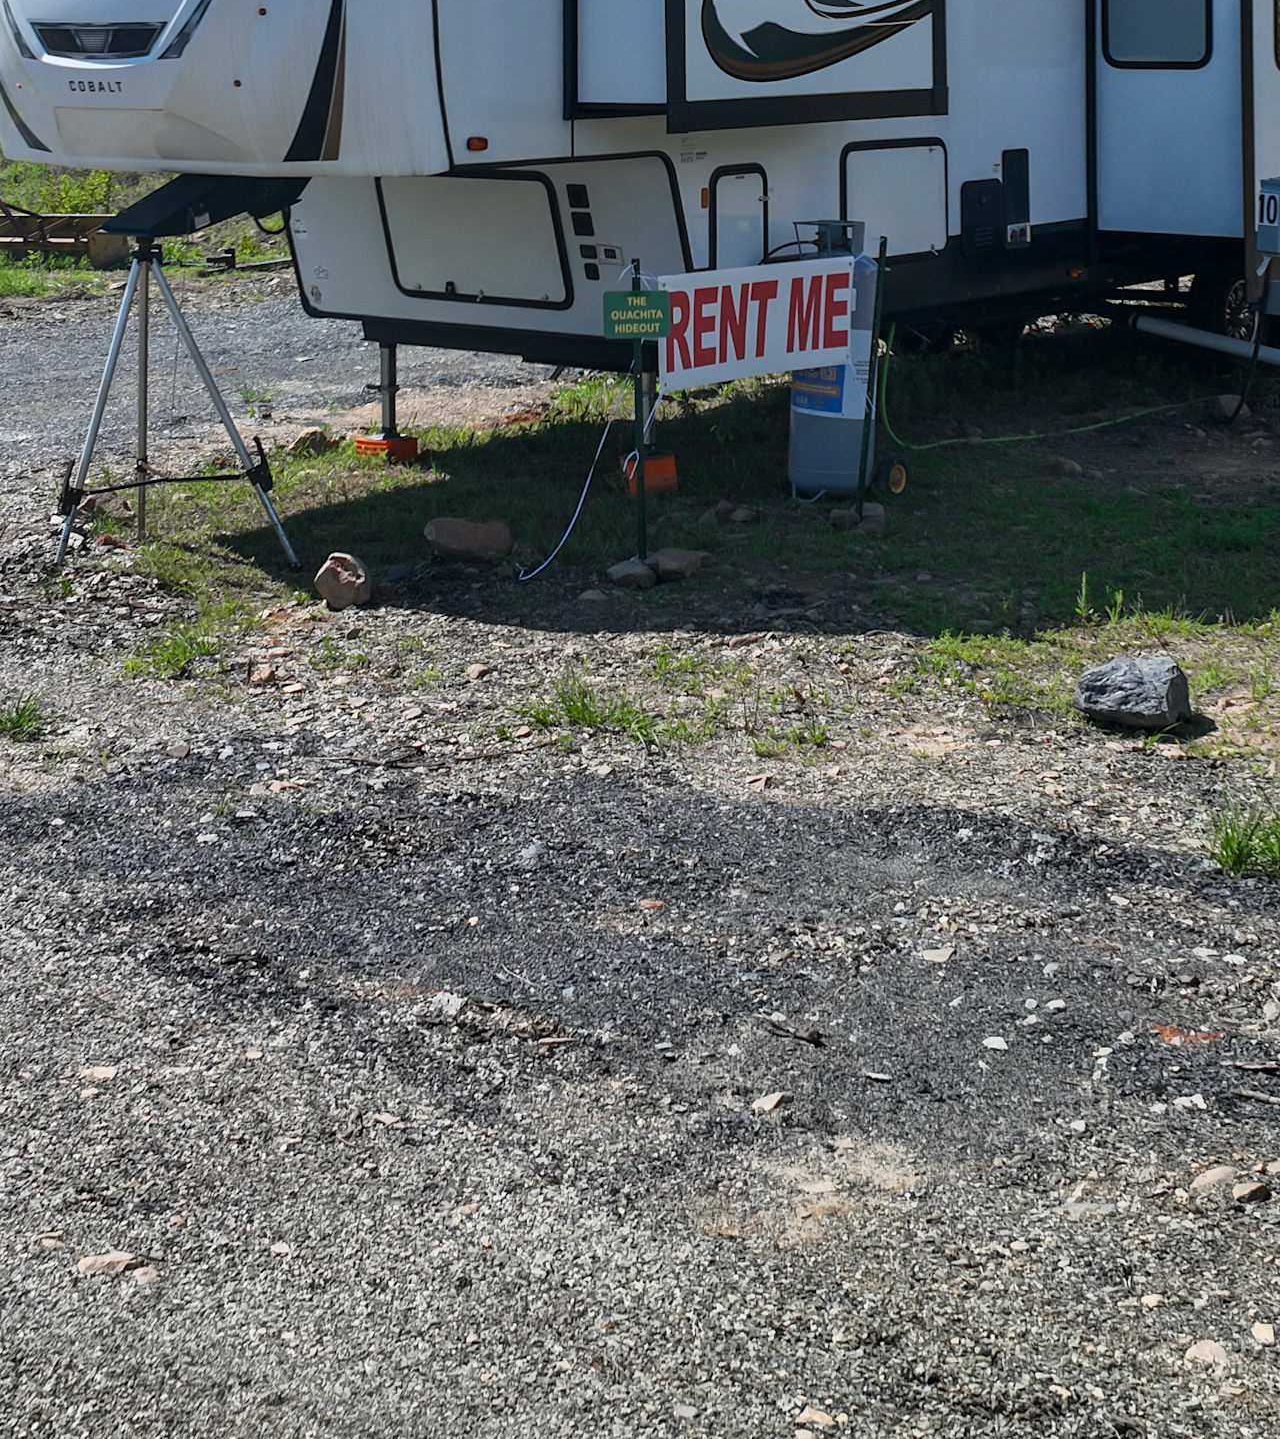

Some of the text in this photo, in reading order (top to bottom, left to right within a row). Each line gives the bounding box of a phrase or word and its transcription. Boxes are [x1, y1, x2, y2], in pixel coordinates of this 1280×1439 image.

[68, 80, 123, 93] COBALT
[1259, 193, 1278, 225] 10
[627, 296, 647, 307] THE
[610, 309, 664, 320] OUACHITA
[614, 323, 661, 333] HIDEOUT
[666, 272, 851, 374] RENT ME
